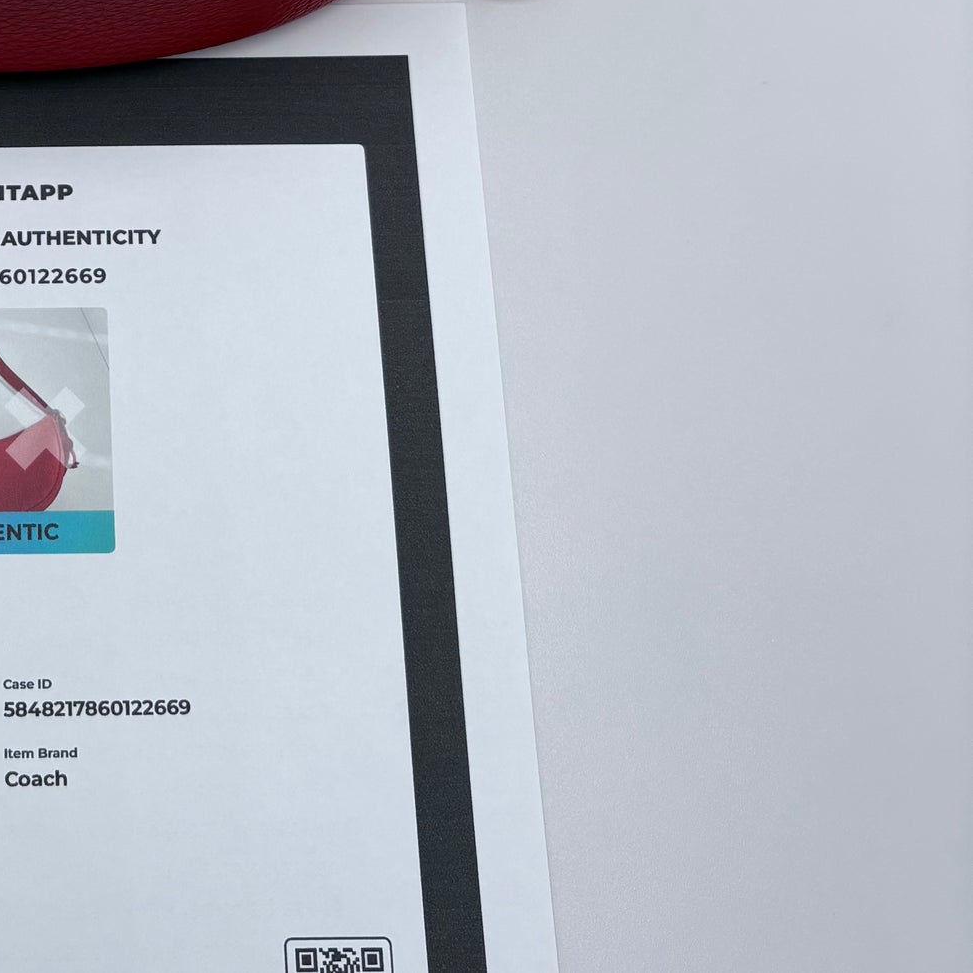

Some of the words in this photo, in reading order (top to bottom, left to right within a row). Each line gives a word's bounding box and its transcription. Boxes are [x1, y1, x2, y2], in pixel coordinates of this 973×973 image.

[0, 229, 162, 247] AUTHENTICITY
[2, 678, 35, 690] Case
[37, 678, 53, 690] ID
[3, 699, 191, 718] 5848217860122669
[4, 748, 35, 759] Item
[38, 746, 78, 759] Brand
[4, 769, 68, 788] Coach
